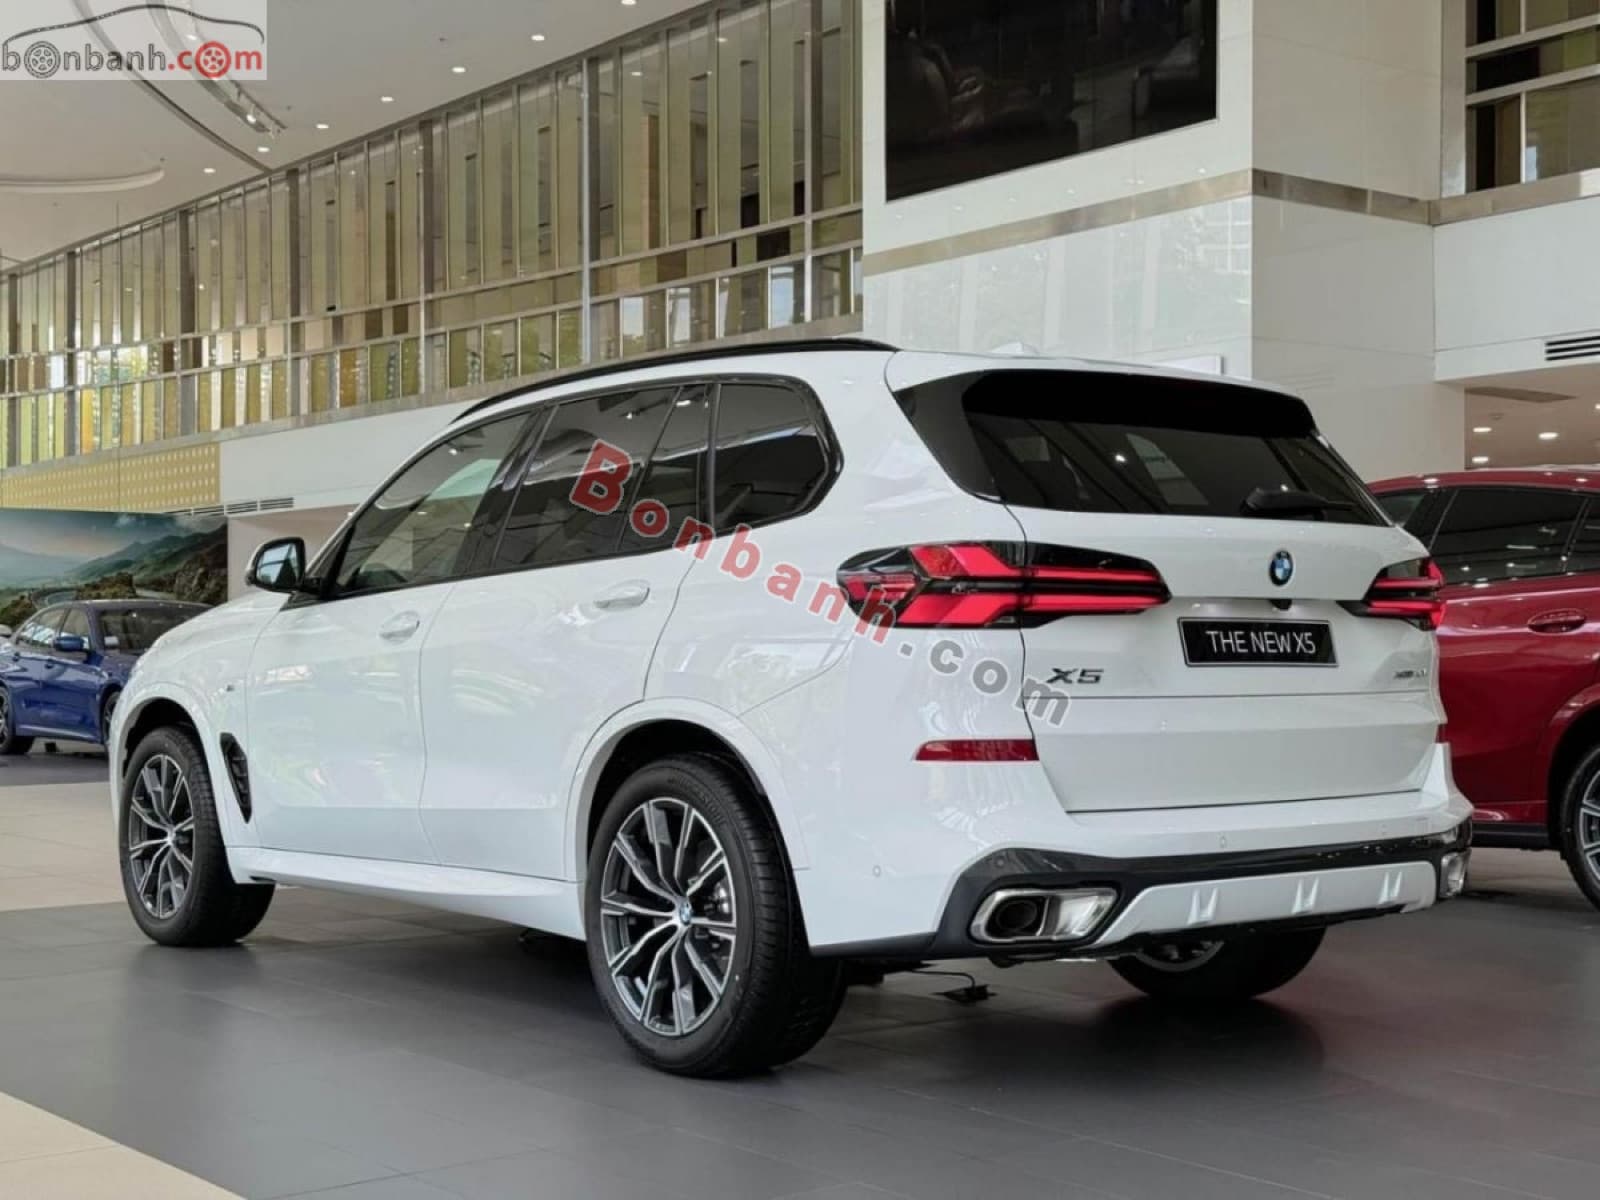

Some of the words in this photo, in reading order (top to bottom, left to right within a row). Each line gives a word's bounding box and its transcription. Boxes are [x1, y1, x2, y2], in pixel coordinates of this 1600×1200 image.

[1205, 630, 1249, 653] THE
[1250, 631, 1292, 653] NEW
[1292, 631, 1317, 654] X5
[1046, 668, 1105, 684] X5
